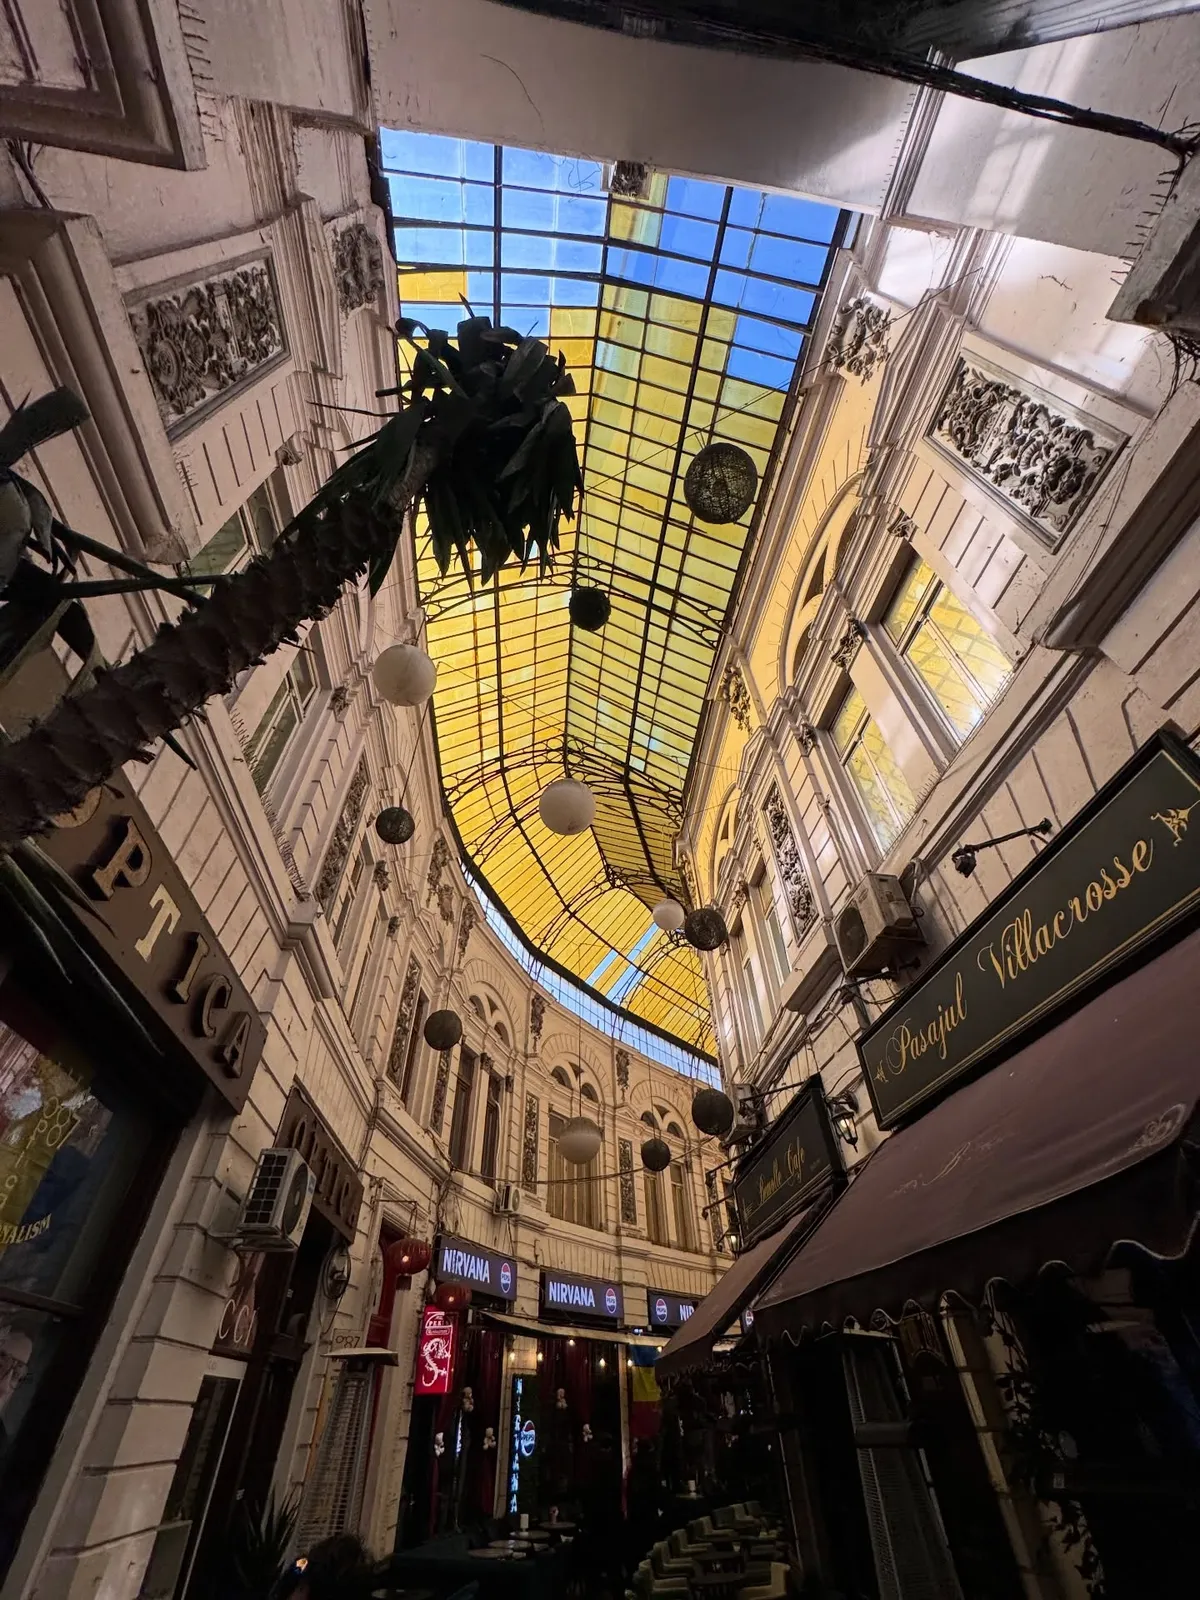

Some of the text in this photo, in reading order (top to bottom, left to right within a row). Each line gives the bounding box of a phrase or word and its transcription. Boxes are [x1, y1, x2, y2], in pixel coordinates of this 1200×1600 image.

[885, 838, 1153, 1074] Pasajul Villacrosse
[443, 1246, 490, 1283] NIRVANA
[549, 1281, 596, 1308] NIRVANA
